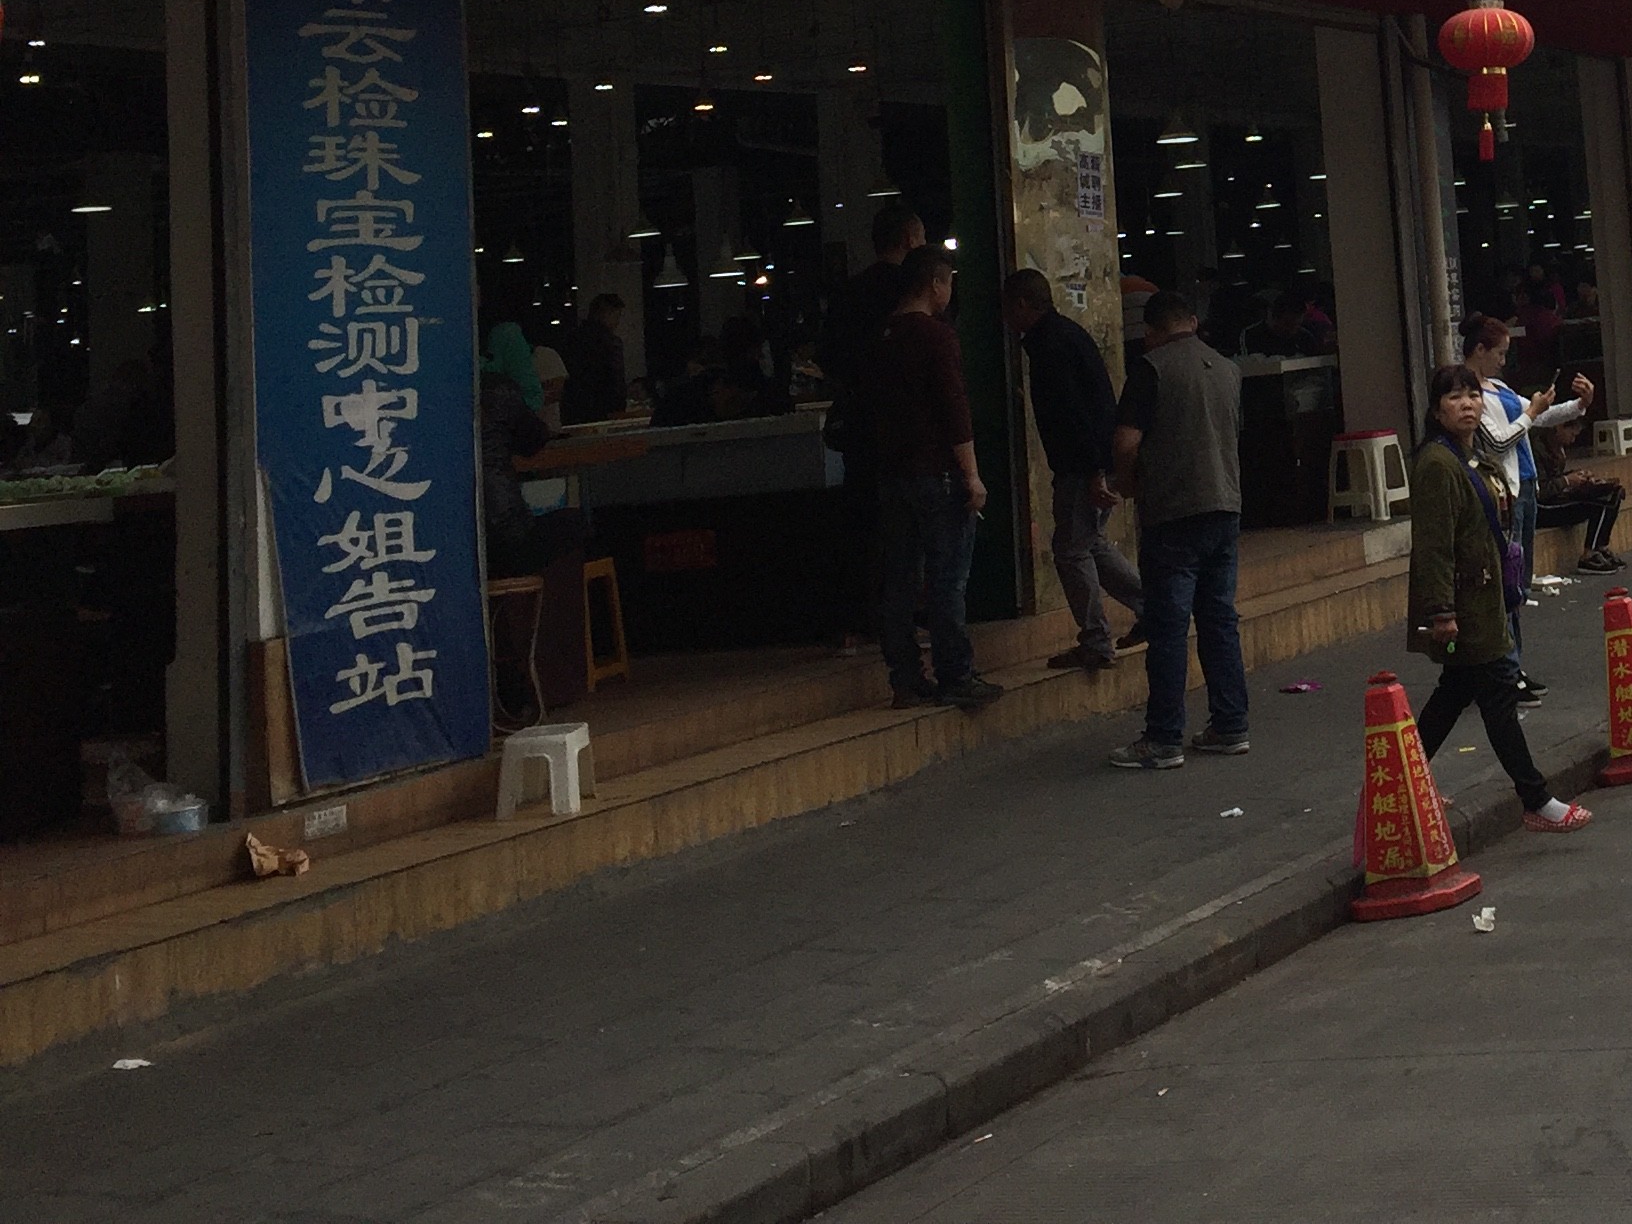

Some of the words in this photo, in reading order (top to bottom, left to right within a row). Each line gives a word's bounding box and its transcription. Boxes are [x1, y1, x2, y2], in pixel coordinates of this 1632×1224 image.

[1366, 735, 1405, 871] 潜水艇地漏
